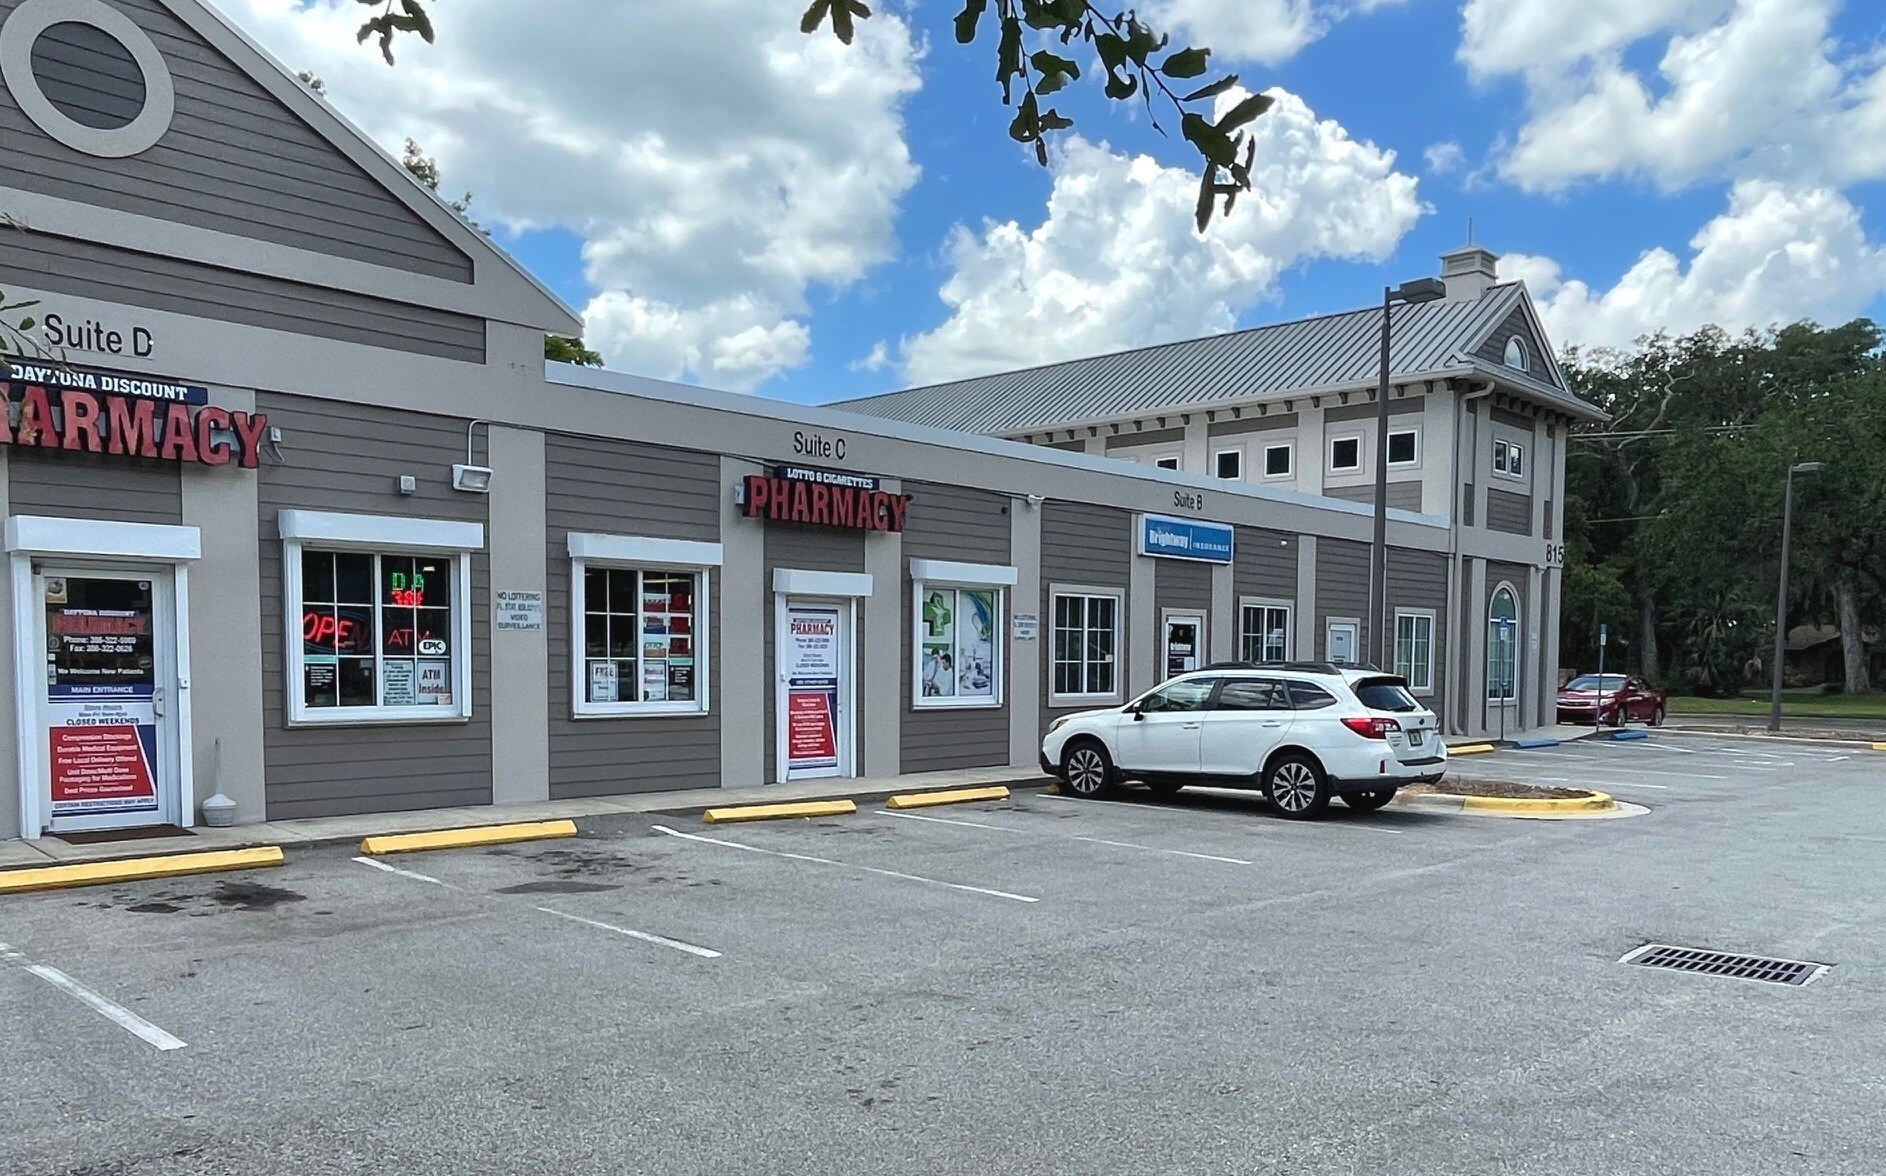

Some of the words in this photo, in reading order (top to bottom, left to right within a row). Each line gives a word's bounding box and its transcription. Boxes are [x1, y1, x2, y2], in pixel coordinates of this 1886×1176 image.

[44, 313, 123, 354] Suite
[132, 326, 154, 358] D
[101, 376, 188, 402] DISCOUNT
[793, 430, 831, 459] Suite
[835, 437, 846, 460] C
[787, 467, 815, 482] LOTTO
[823, 473, 873, 489] CIGARETTES
[745, 475, 908, 533] PHARMACY
[1173, 490, 1195, 510] Suite
[1196, 494, 1203, 511] B
[1192, 541, 1230, 552] INSURANCE
[1546, 544, 1564, 564] 815
[790, 623, 835, 635] PHARMACY
[422, 669, 440, 680] ATM
[71, 686, 91, 694] MAIN
[92, 686, 134, 694] ENTRANCE
[418, 683, 445, 694] Inside
